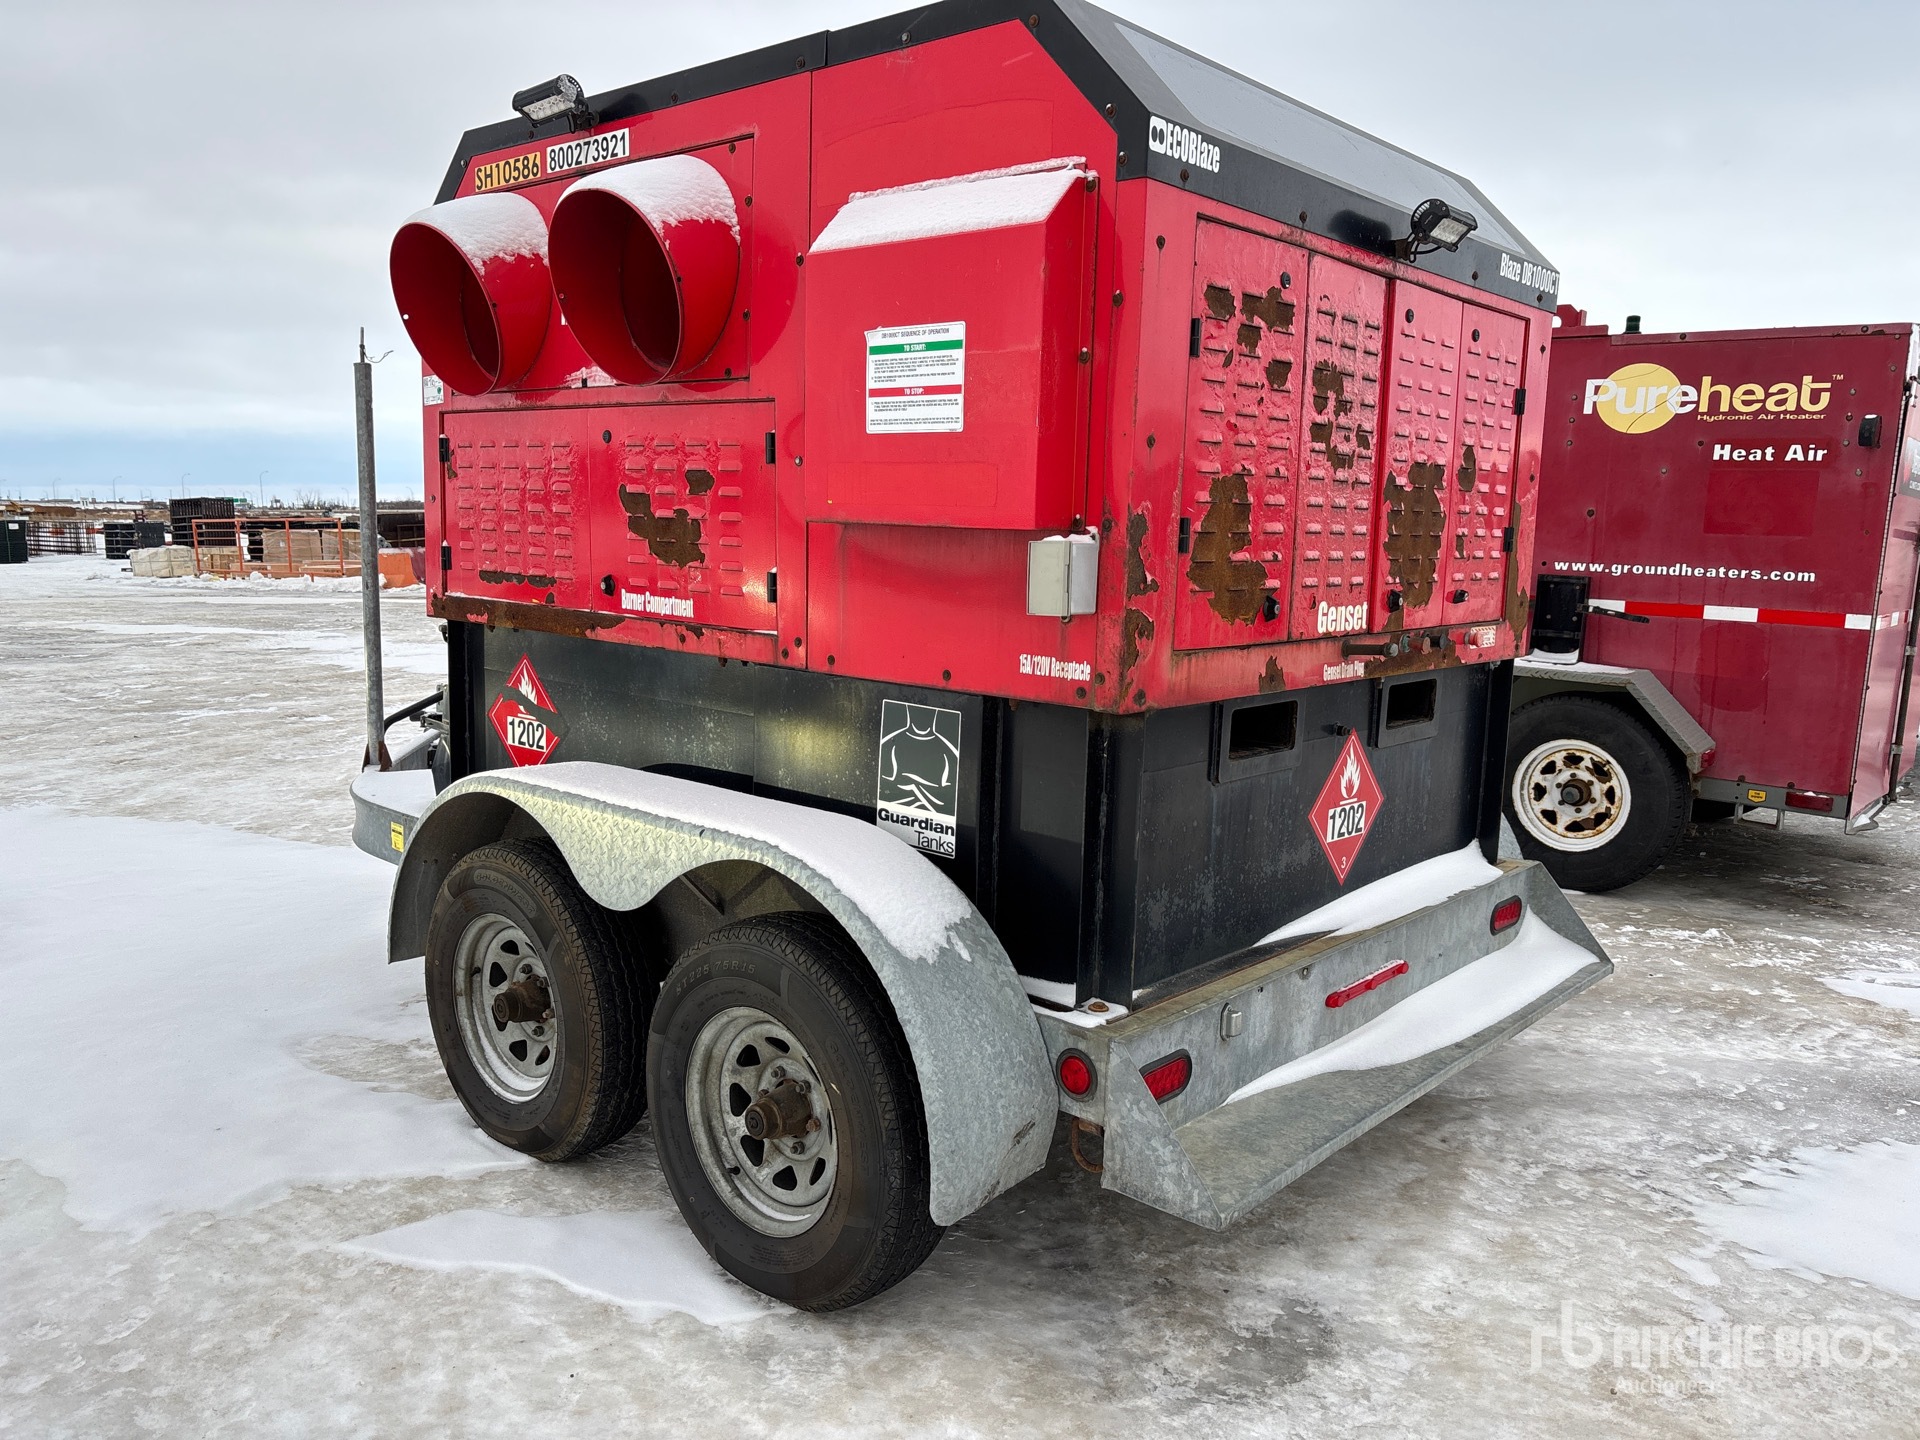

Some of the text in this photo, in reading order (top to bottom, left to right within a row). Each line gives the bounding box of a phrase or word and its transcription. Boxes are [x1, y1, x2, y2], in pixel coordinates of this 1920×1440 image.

[549, 131, 626, 172] 800273921
[1166, 122, 1220, 173] ECOBlaze
[476, 154, 539, 191] SH10586
[1500, 252, 1521, 282] Blaze
[1583, 375, 1832, 414] Pureheat
[1697, 414, 1753, 422] Hydronic
[1712, 444, 1828, 462] Heat Air
[1554, 561, 1816, 582] www.groundheaters.com
[621, 588, 694, 618] Burner Compartment
[1317, 601, 1368, 633] Genset
[1051, 656, 1091, 681] Receptacle
[1323, 664, 1341, 681] Genset
[508, 718, 545, 750] 1202
[878, 808, 955, 836] Guardian
[1329, 803, 1364, 840] 1202
[914, 830, 954, 854] Tanks
[1340, 856, 1346, 869] 3
